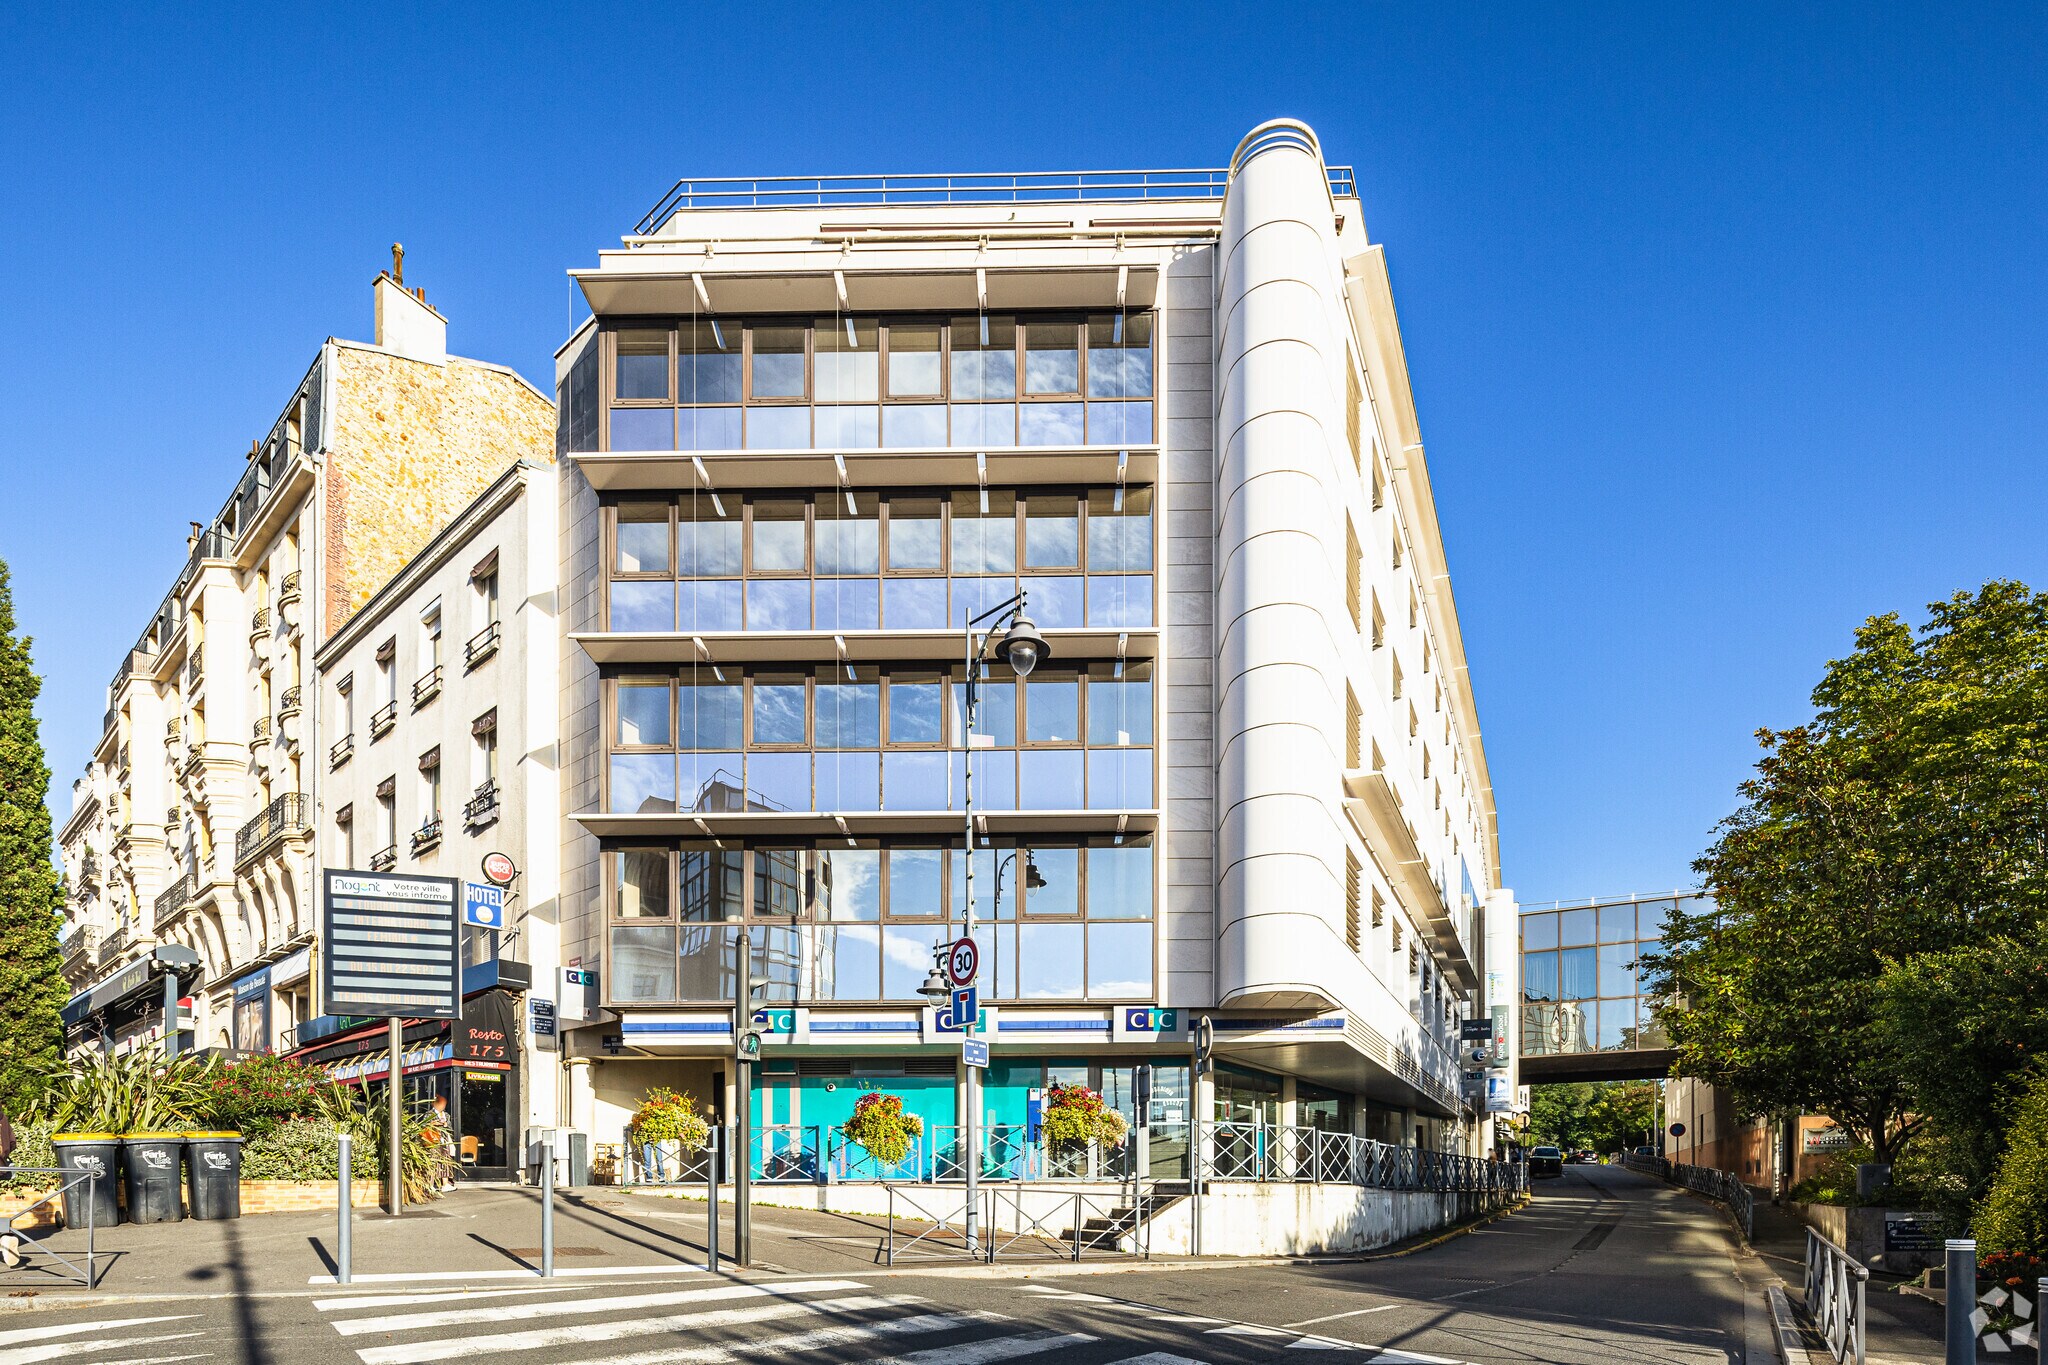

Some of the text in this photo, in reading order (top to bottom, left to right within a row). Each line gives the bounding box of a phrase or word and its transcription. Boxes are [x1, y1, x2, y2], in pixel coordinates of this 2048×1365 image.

[393, 883, 441, 893] Votre ville
[386, 890, 448, 900] vous informe
[467, 886, 502, 907] HOTEL
[955, 951, 973, 973] 30
[568, 972, 592, 984] CIC
[1130, 1012, 1172, 1028] CIC
[469, 1028, 505, 1041] Resto
[358, 1040, 369, 1051] 175
[469, 1044, 505, 1057] 175
[74, 1154, 99, 1164] Paris
[142, 1150, 167, 1160] Paris
[204, 1151, 227, 1161] Paris
